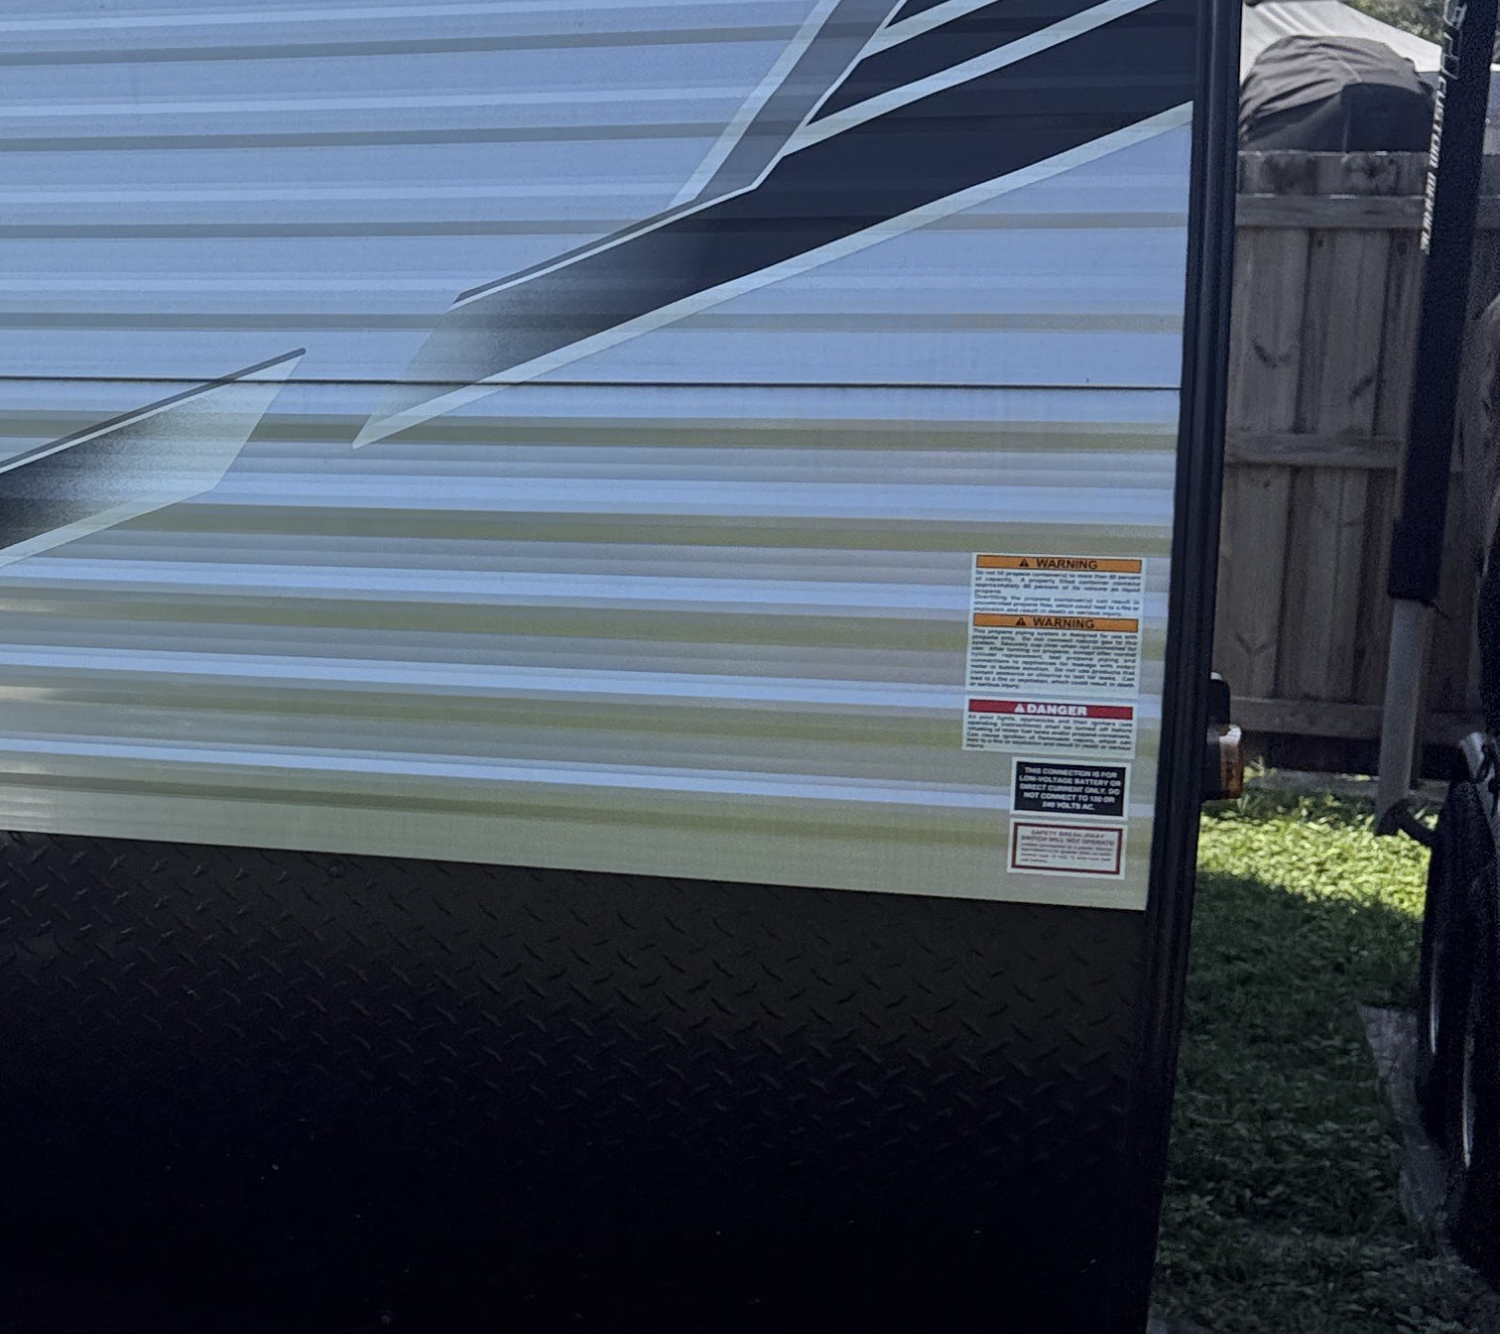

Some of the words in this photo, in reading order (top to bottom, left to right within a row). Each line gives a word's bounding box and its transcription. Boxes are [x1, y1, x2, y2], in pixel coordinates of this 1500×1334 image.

[1036, 558, 1098, 570] WARNING
[1033, 619, 1095, 630] WARNING
[1027, 704, 1088, 716] DANGER
